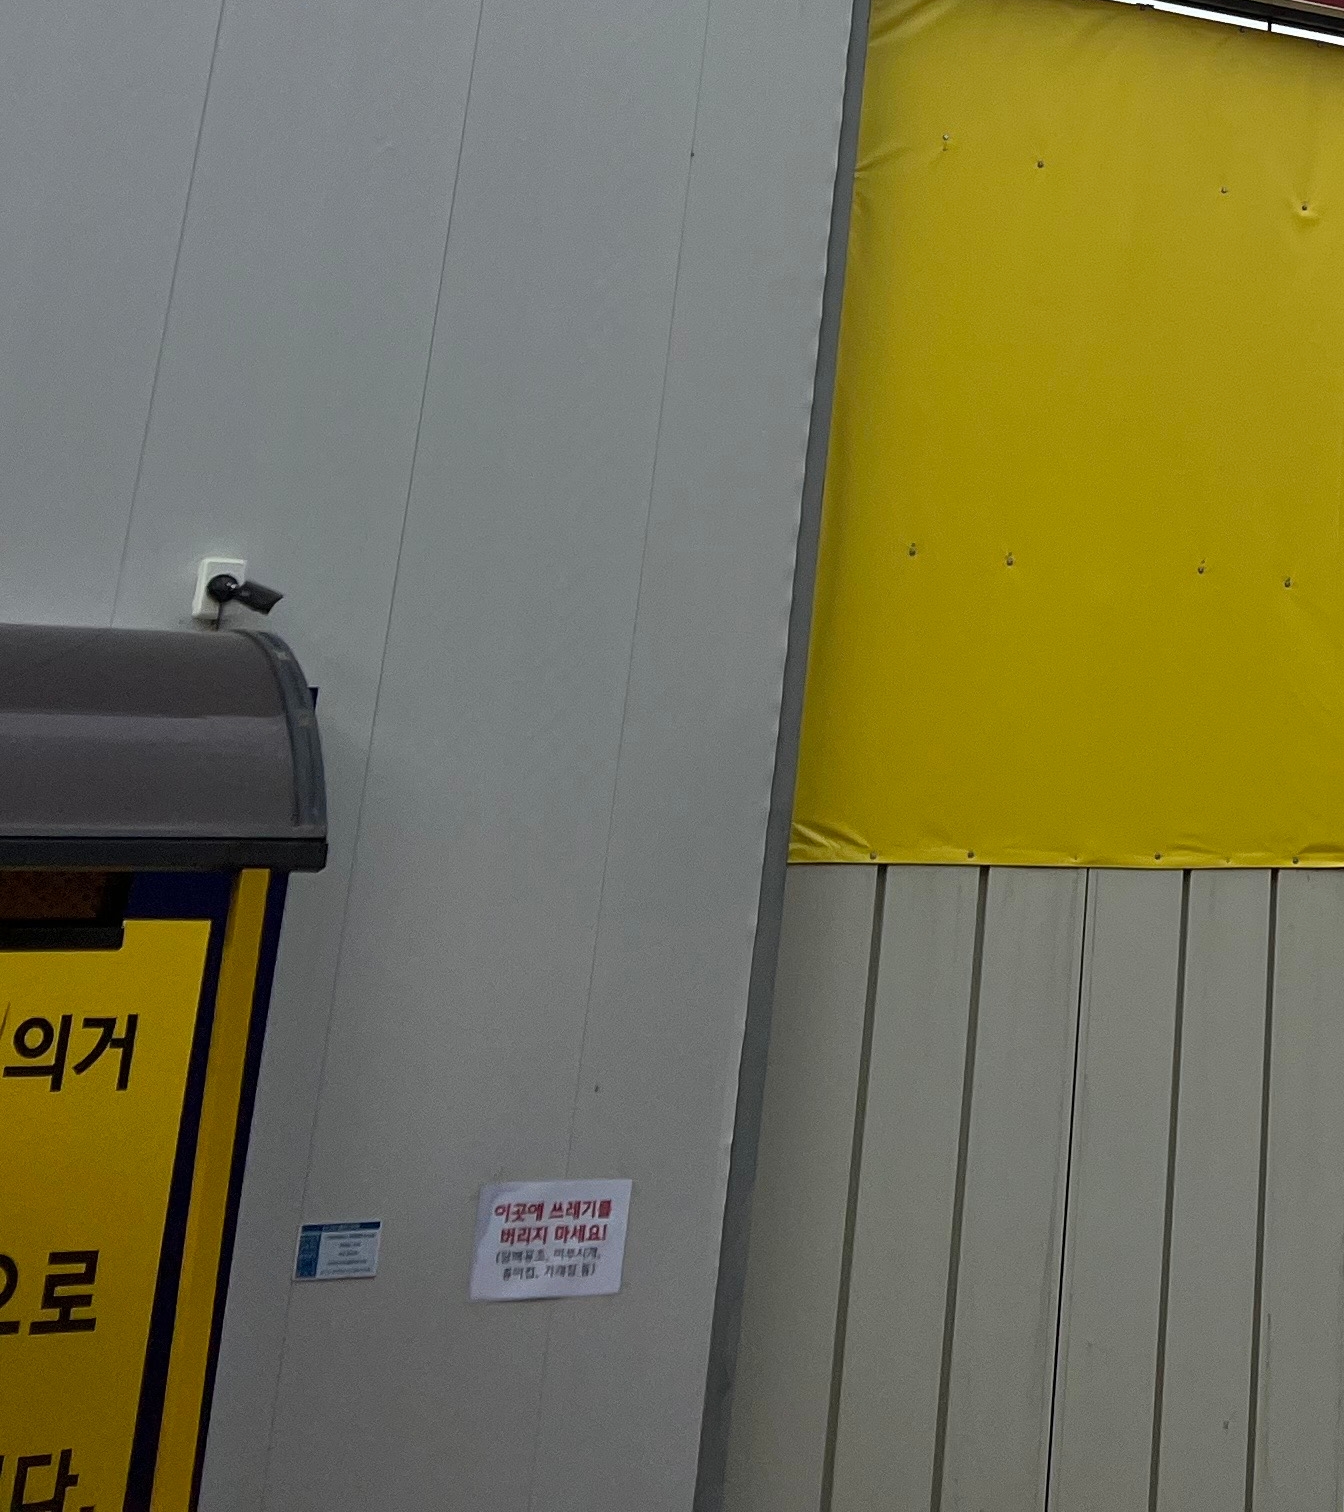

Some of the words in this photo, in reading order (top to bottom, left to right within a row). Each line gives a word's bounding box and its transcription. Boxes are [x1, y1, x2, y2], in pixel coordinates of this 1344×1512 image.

[3, 1013, 139, 1093] 의거
[494, 1200, 545, 1223] 이곳에
[548, 1198, 612, 1220] 쓰레기를
[500, 1225, 549, 1245] 버리지
[554, 1223, 608, 1244] 마세요!
